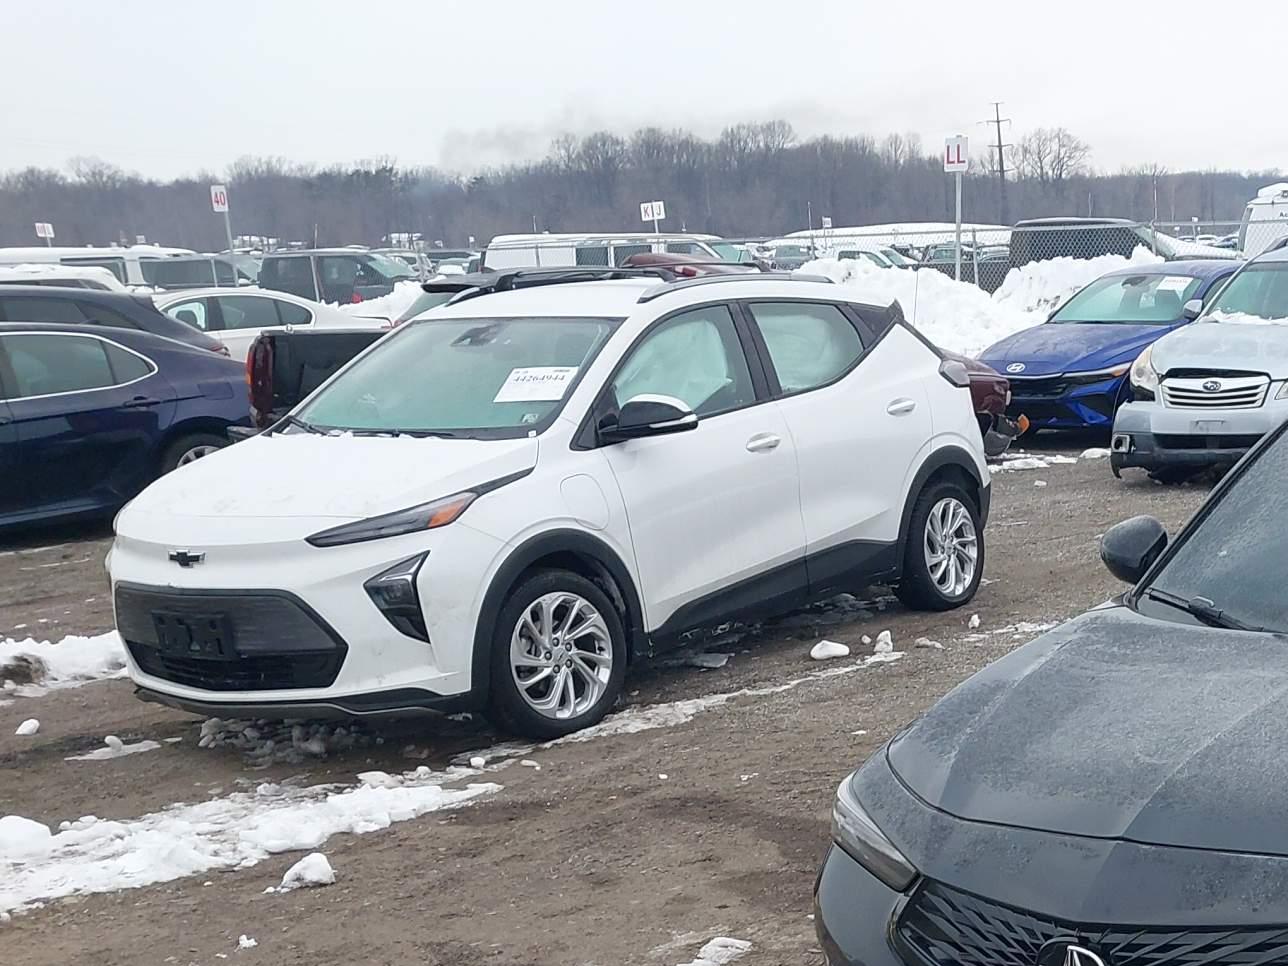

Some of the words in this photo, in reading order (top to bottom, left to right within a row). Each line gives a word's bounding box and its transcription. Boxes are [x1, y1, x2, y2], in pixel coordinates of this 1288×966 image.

[946, 143, 966, 164] LL
[214, 191, 226, 206] 40
[643, 205, 650, 218] K
